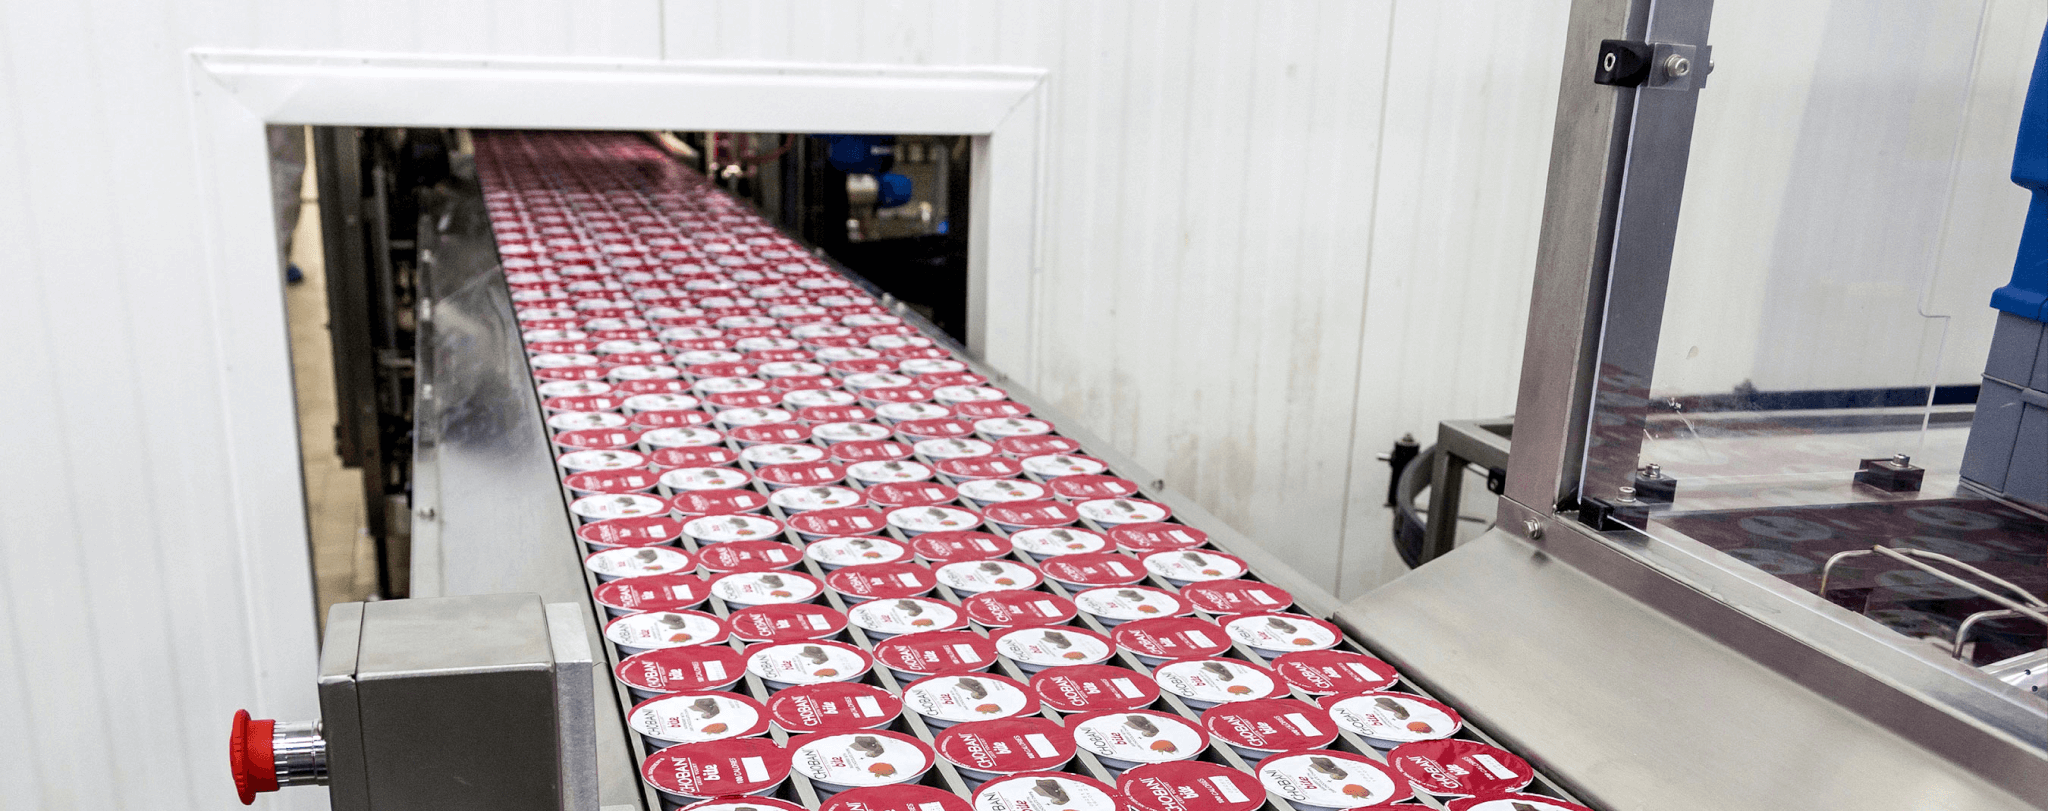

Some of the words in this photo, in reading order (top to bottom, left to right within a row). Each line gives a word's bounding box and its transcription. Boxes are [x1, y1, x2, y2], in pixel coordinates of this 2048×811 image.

[1050, 674, 1085, 706] CHOBANI
[791, 696, 818, 726] CHOBANI
[822, 702, 838, 714] bite
[1220, 715, 1264, 746] CHOBANI
[1257, 722, 1277, 734] bite
[958, 732, 993, 768] CHOBANI
[993, 742, 1012, 754] bite
[702, 764, 720, 781] bite
[802, 748, 826, 779] CHOBANI
[832, 756, 846, 768] bite
[1406, 755, 1459, 789] CHOBANI
[1446, 764, 1470, 776] bite
[672, 756, 696, 794] CHOBANI
[1264, 768, 1306, 801] CHOBANI
[1298, 776, 1317, 790] bite
[1178, 786, 1199, 799] bite
